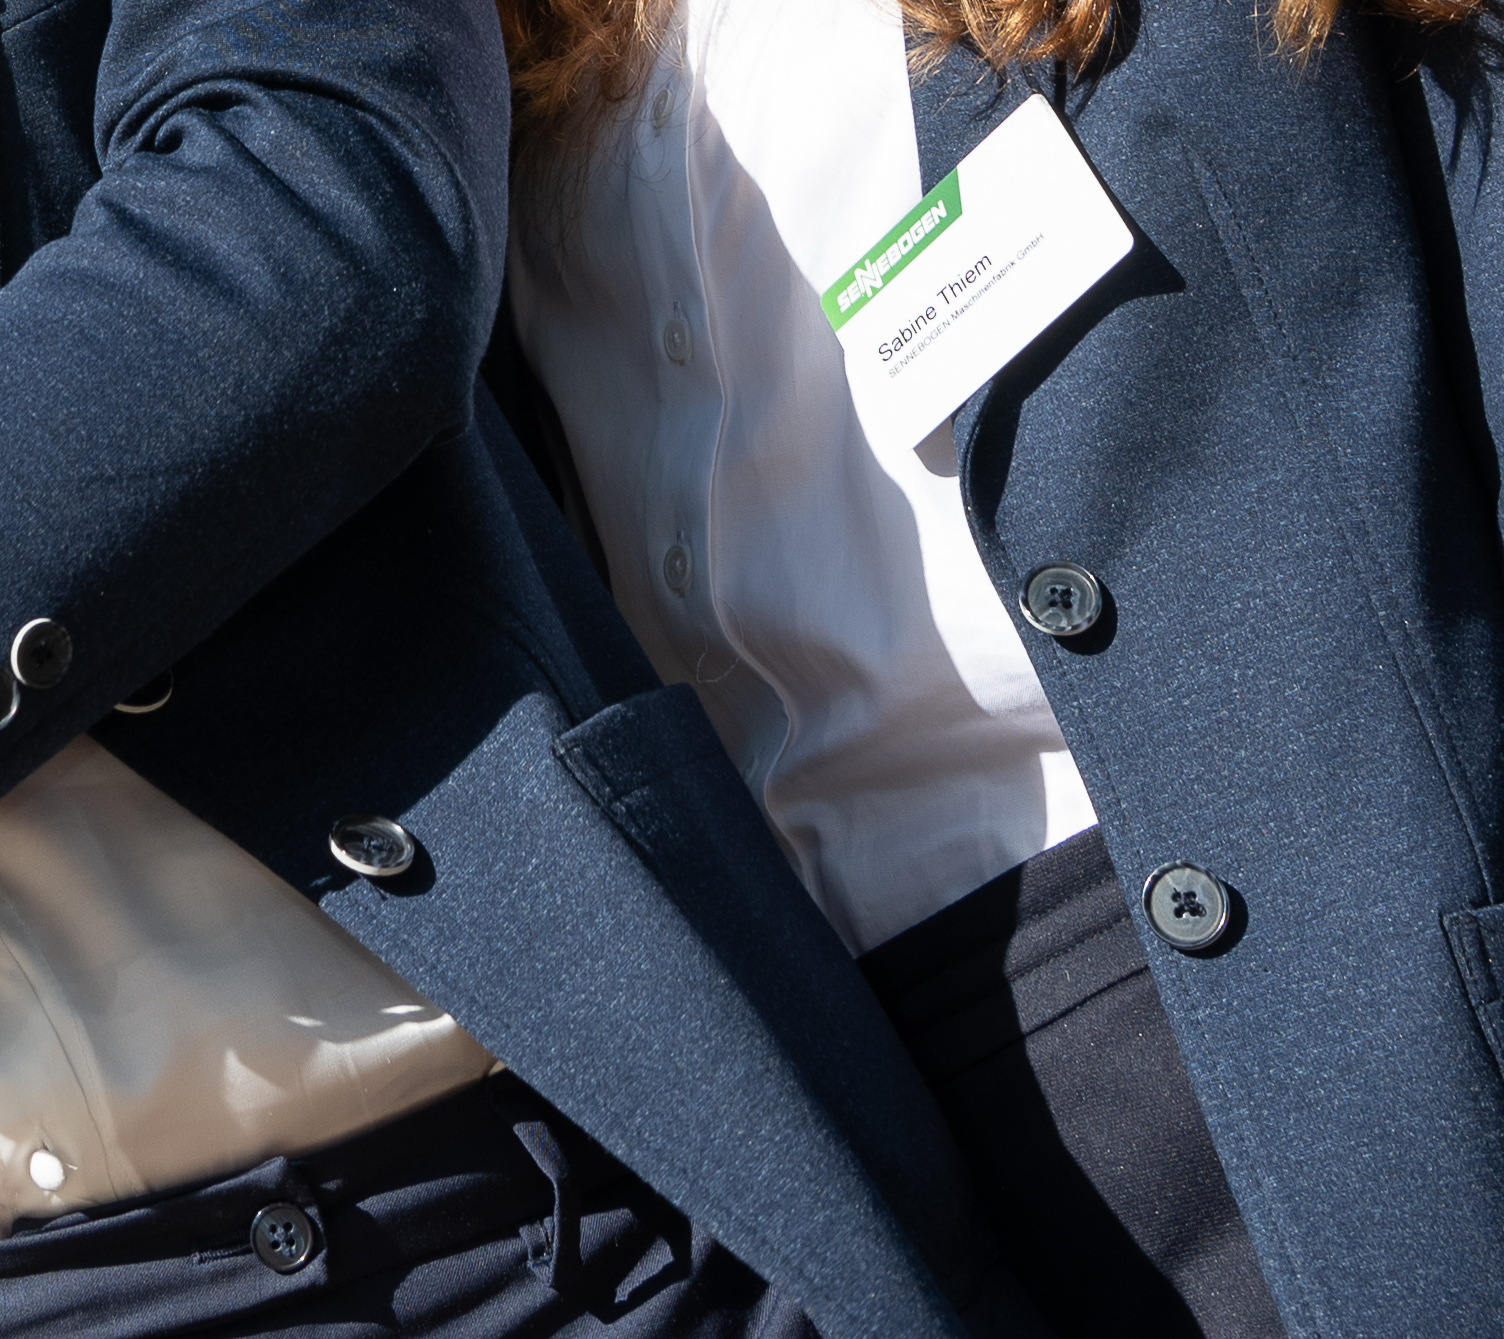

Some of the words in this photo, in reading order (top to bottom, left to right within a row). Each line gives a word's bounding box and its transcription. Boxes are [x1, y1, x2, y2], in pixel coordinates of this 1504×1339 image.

[836, 199, 948, 313] SENNEBOGEN
[878, 306, 937, 362] Sabine
[936, 255, 993, 305] Thiem
[889, 319, 951, 378] SENNEBOGEN
[950, 260, 1016, 321] Maschinenfabrik
[1016, 232, 1045, 261] GmbH
